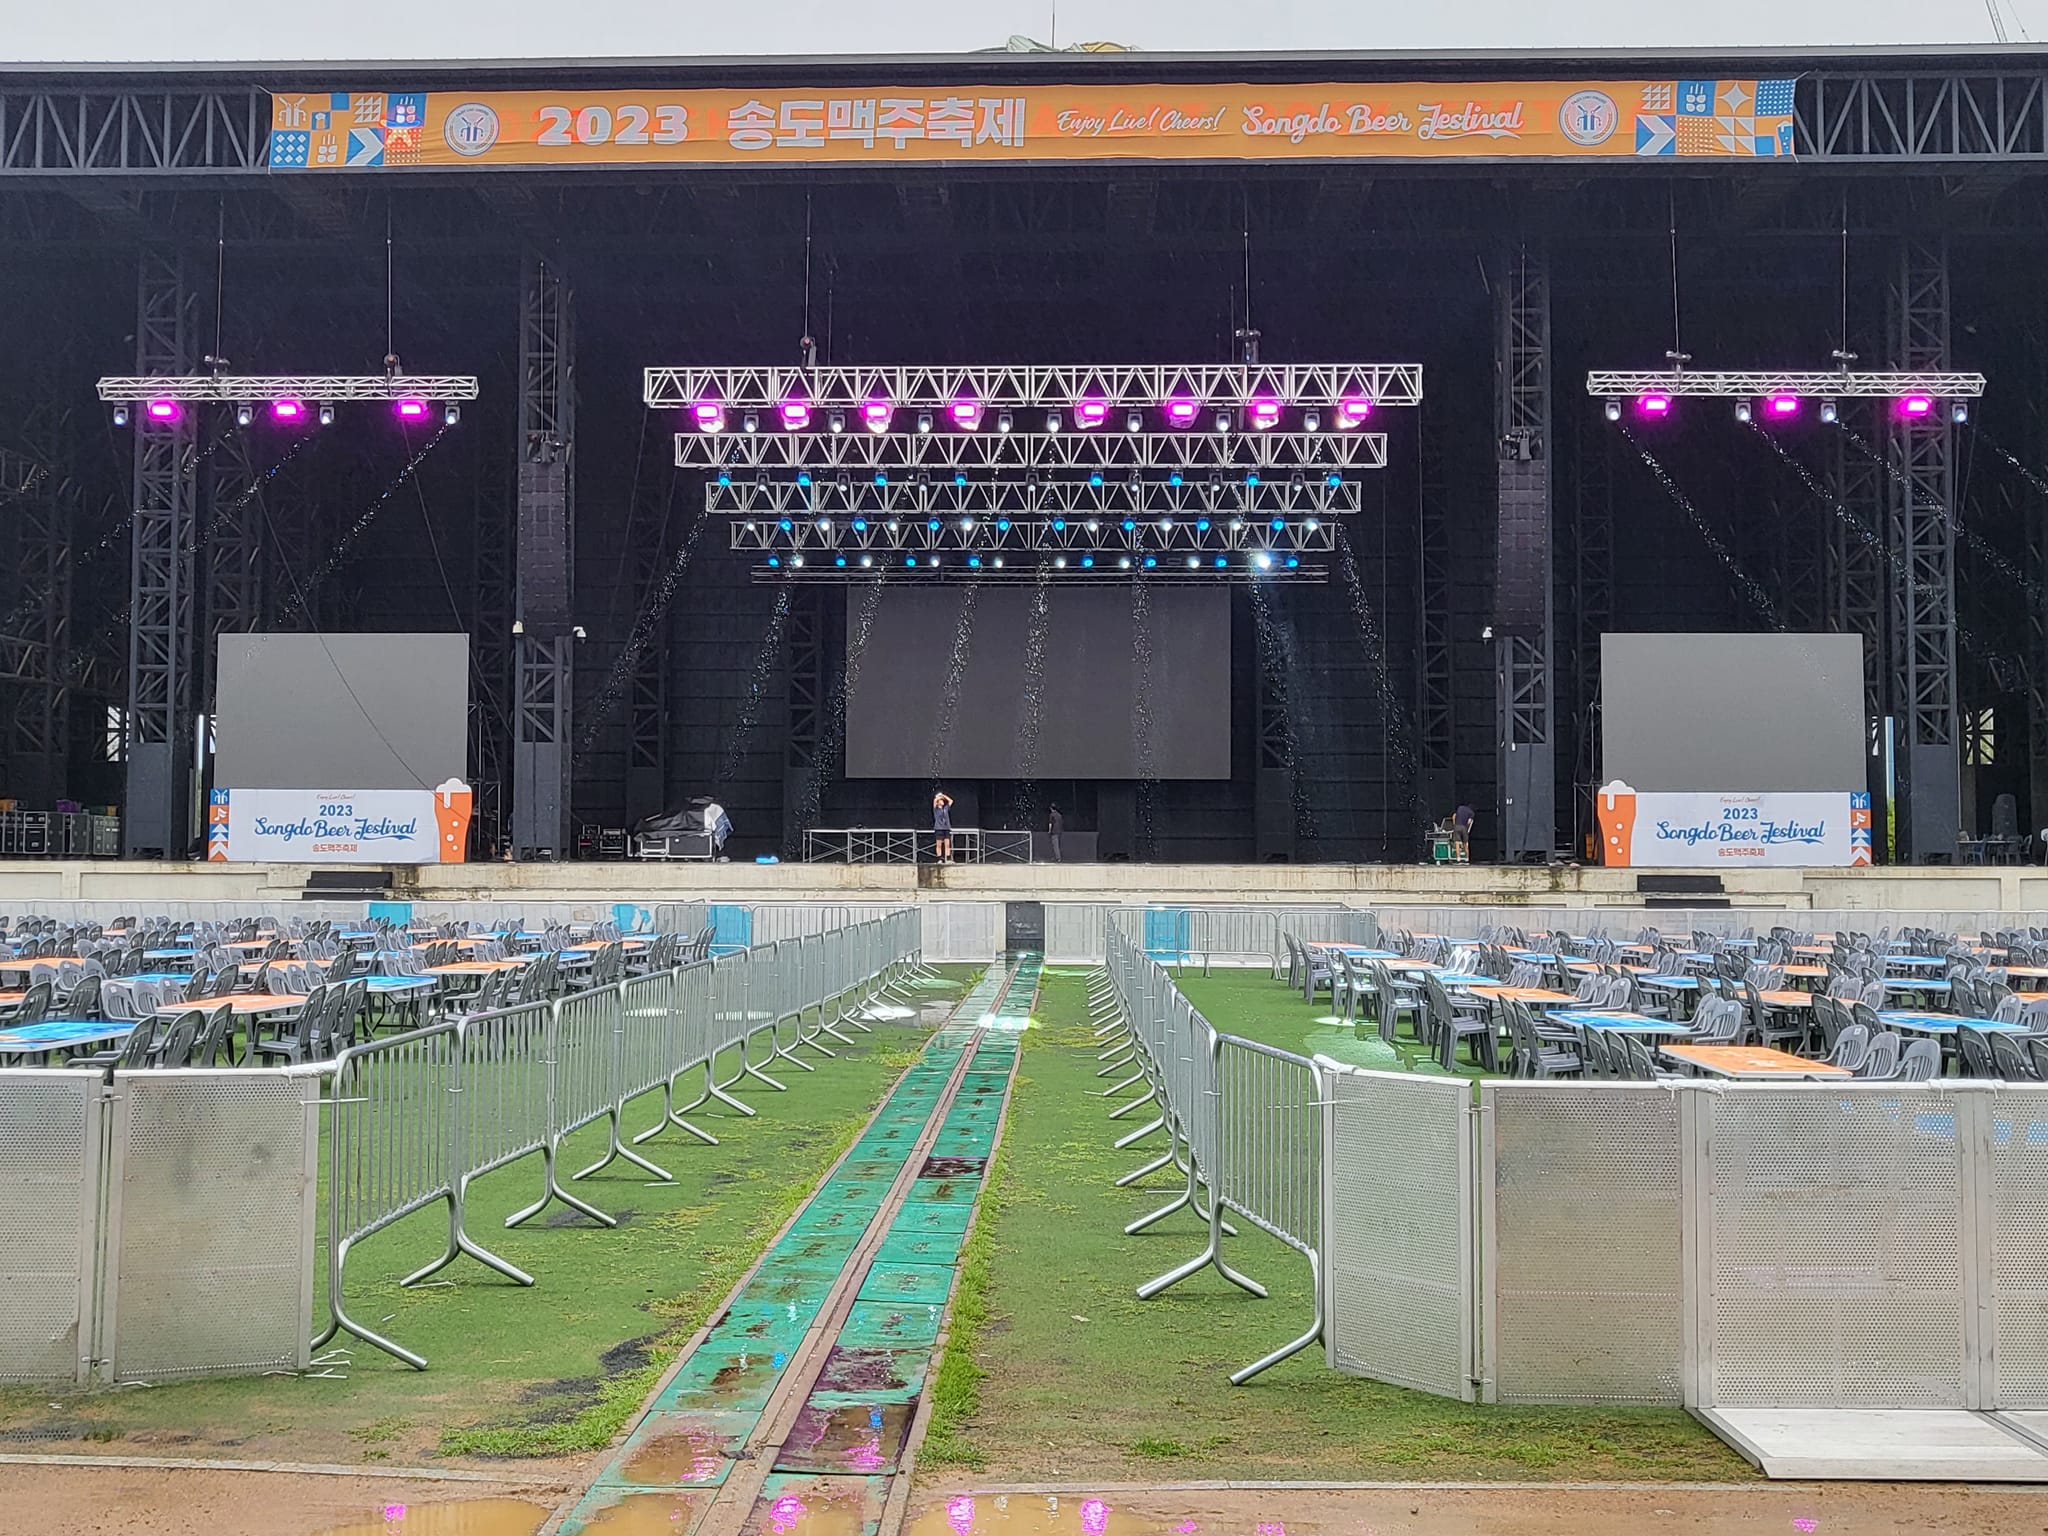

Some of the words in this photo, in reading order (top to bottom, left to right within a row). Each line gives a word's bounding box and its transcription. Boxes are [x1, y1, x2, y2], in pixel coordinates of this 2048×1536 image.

[537, 105, 689, 146] 2023
[727, 97, 1026, 150] 송도맥주축제
[1057, 110, 1105, 136] Enjoy
[1107, 107, 1160, 132] Live!
[1160, 107, 1226, 131] Cheers!
[1241, 103, 1342, 144] Songdo
[1346, 104, 1412, 134] Beer
[1416, 102, 1524, 140] Festival
[319, 804, 353, 817] 2023
[1723, 807, 1759, 820] 2023
[254, 817, 314, 842] Songdo
[313, 819, 353, 838] Beer
[354, 817, 417, 841] Festival
[1656, 820, 1719, 846] Songdo
[1718, 822, 1759, 842] Beer
[1760, 820, 1825, 845] Festival
